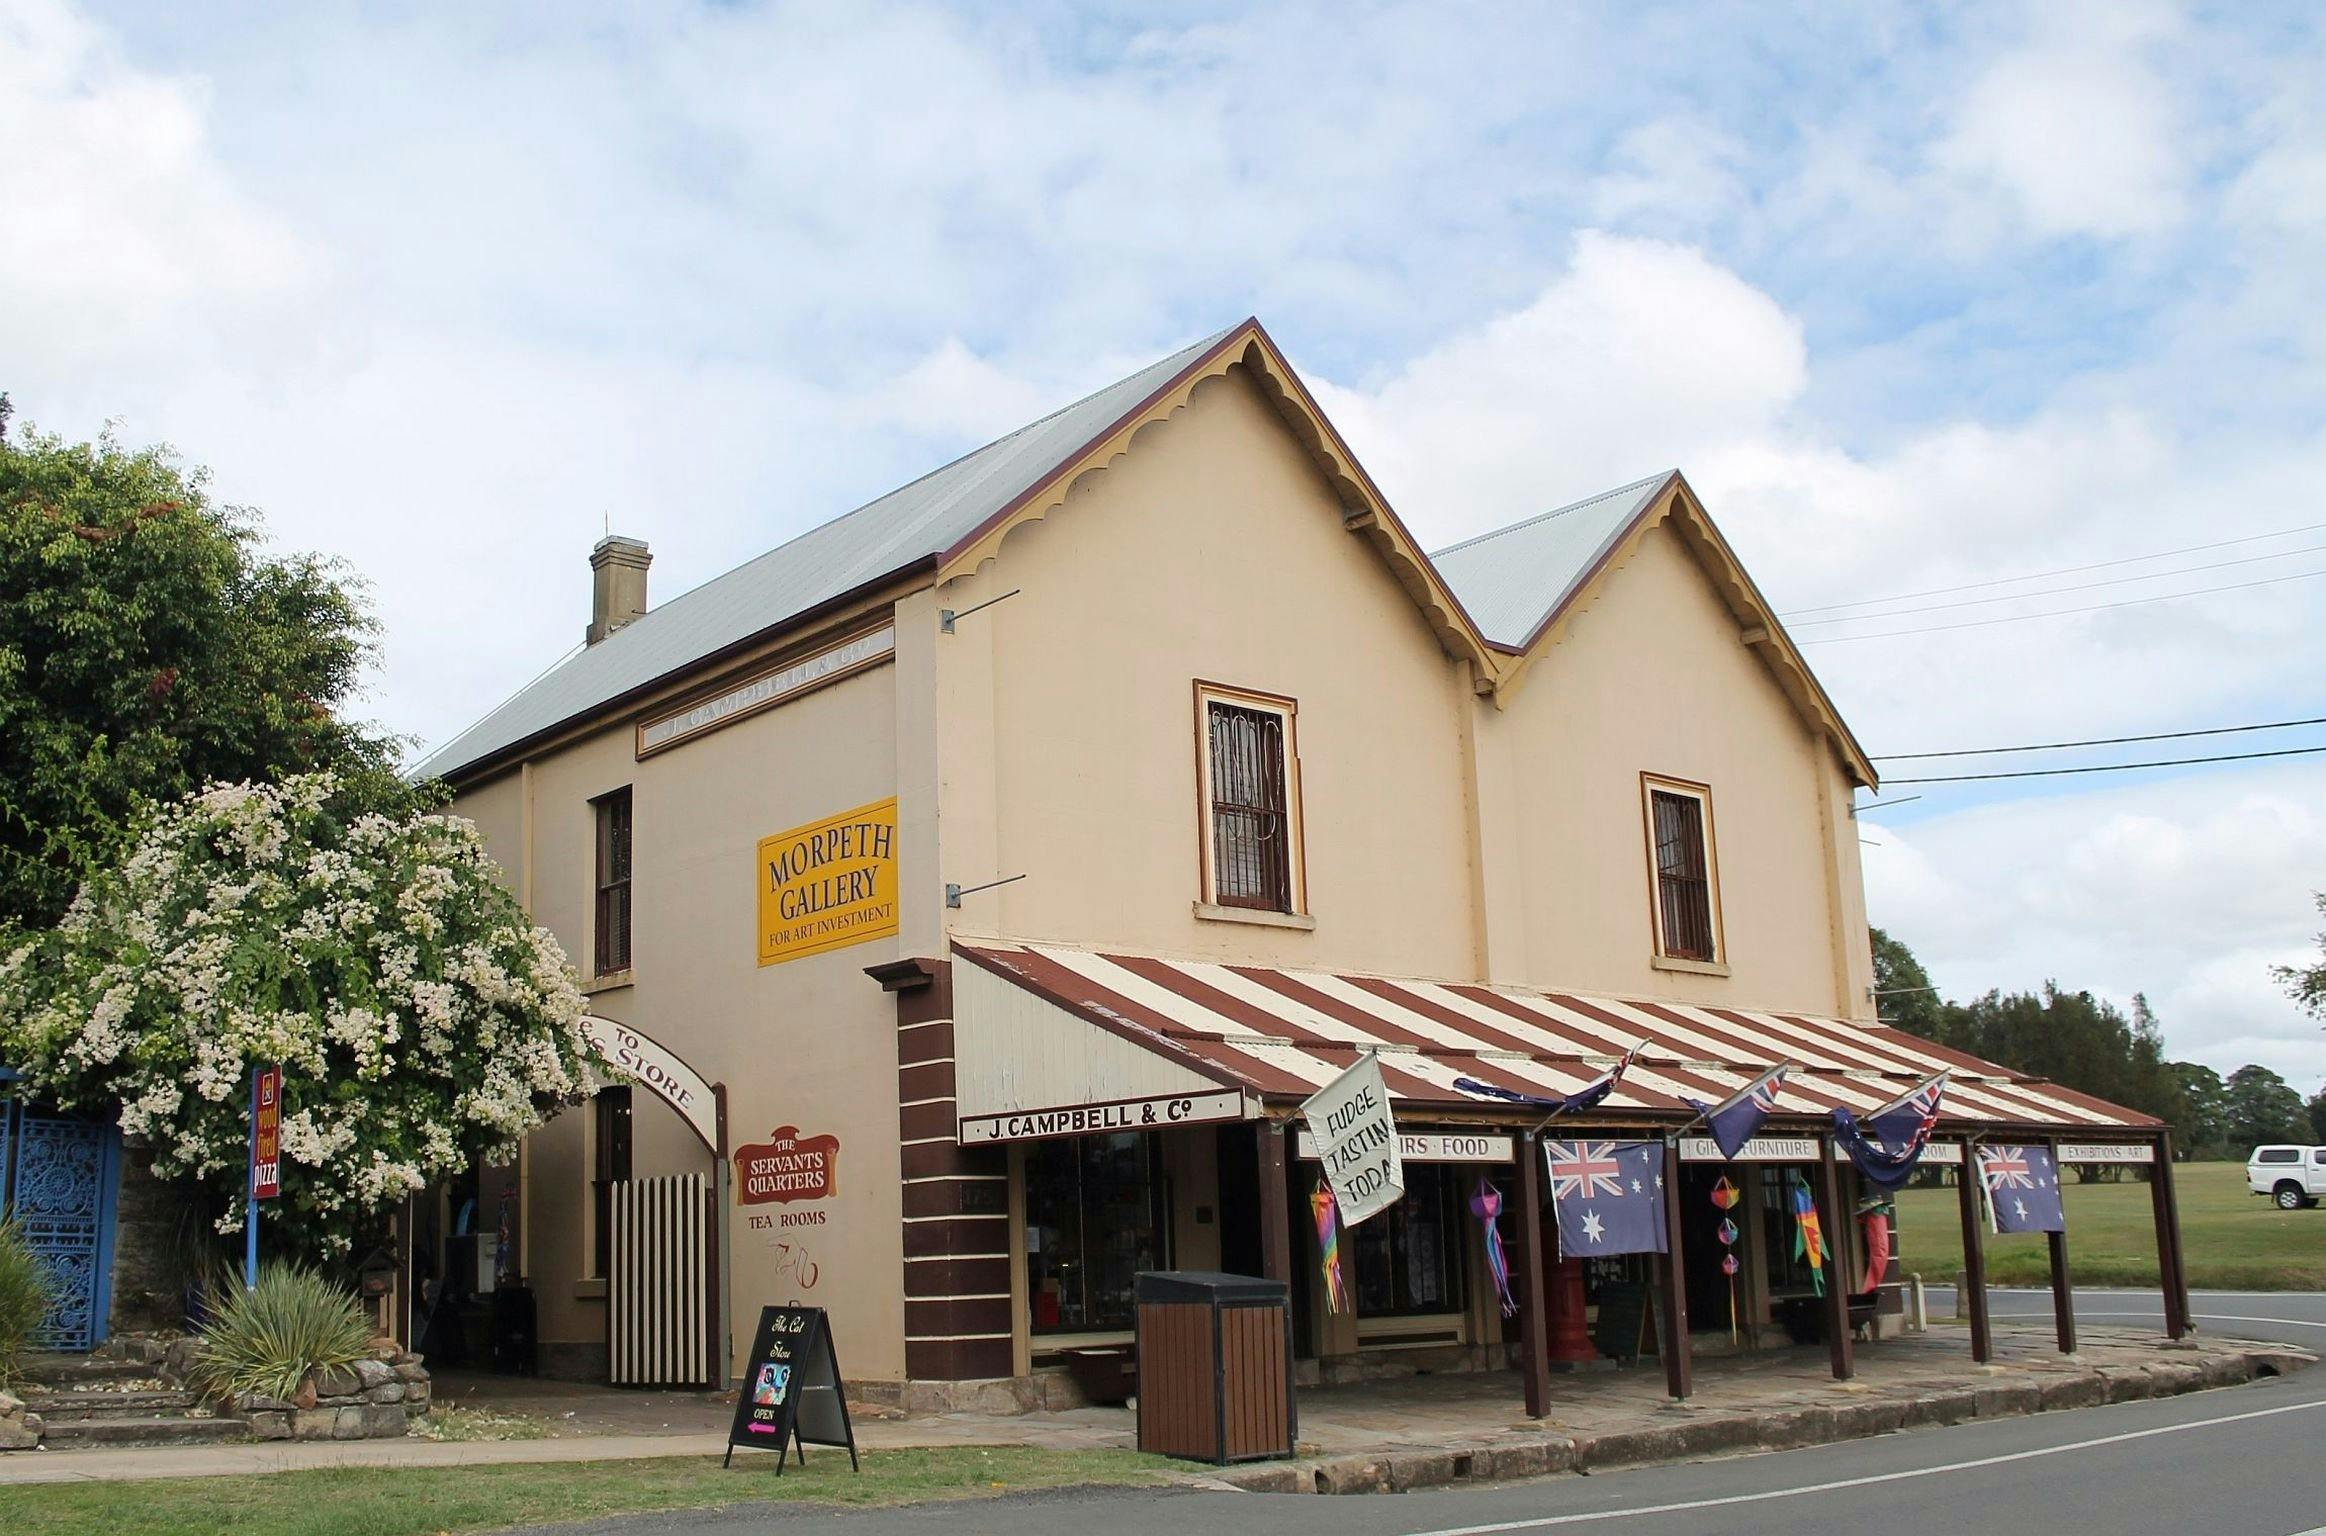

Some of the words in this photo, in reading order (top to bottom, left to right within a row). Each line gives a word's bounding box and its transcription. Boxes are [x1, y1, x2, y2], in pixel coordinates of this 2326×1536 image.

[768, 822, 894, 894] MORPETH
[780, 864, 879, 921] GALLERY
[769, 932, 791, 947] FOR
[793, 922, 816, 940] ART
[817, 902, 892, 935] INVESTMENT
[615, 1027, 639, 1050] TO
[617, 1048, 695, 1110] STORE
[257, 1101, 278, 1129] wood
[1008, 1105, 1133, 1137] CAMPBELL
[1141, 1103, 1158, 1125] &
[1327, 1085, 1378, 1138] FUDGE
[256, 1130, 276, 1161] fired
[775, 1139, 796, 1152] THE
[1327, 1117, 1390, 1175] TASTIN
[1442, 1137, 1489, 1156] FOOD
[1695, 1140, 1718, 1156] GIF
[1742, 1141, 1809, 1156] FURNITURE
[1923, 1144, 1947, 1159] OOM
[2068, 1146, 2122, 1159] EXHIBITIONS
[2127, 1147, 2143, 1159] ART
[254, 1159, 277, 1193] pizza
[750, 1151, 824, 1175] SERVANTS
[748, 1171, 824, 1197] QUARTERS
[1343, 1158, 1391, 1202] TODA
[749, 1215, 773, 1230] TEA
[781, 1211, 827, 1228] ROOMS
[771, 1314, 788, 1333] The
[753, 1408, 775, 1420] OPEN
